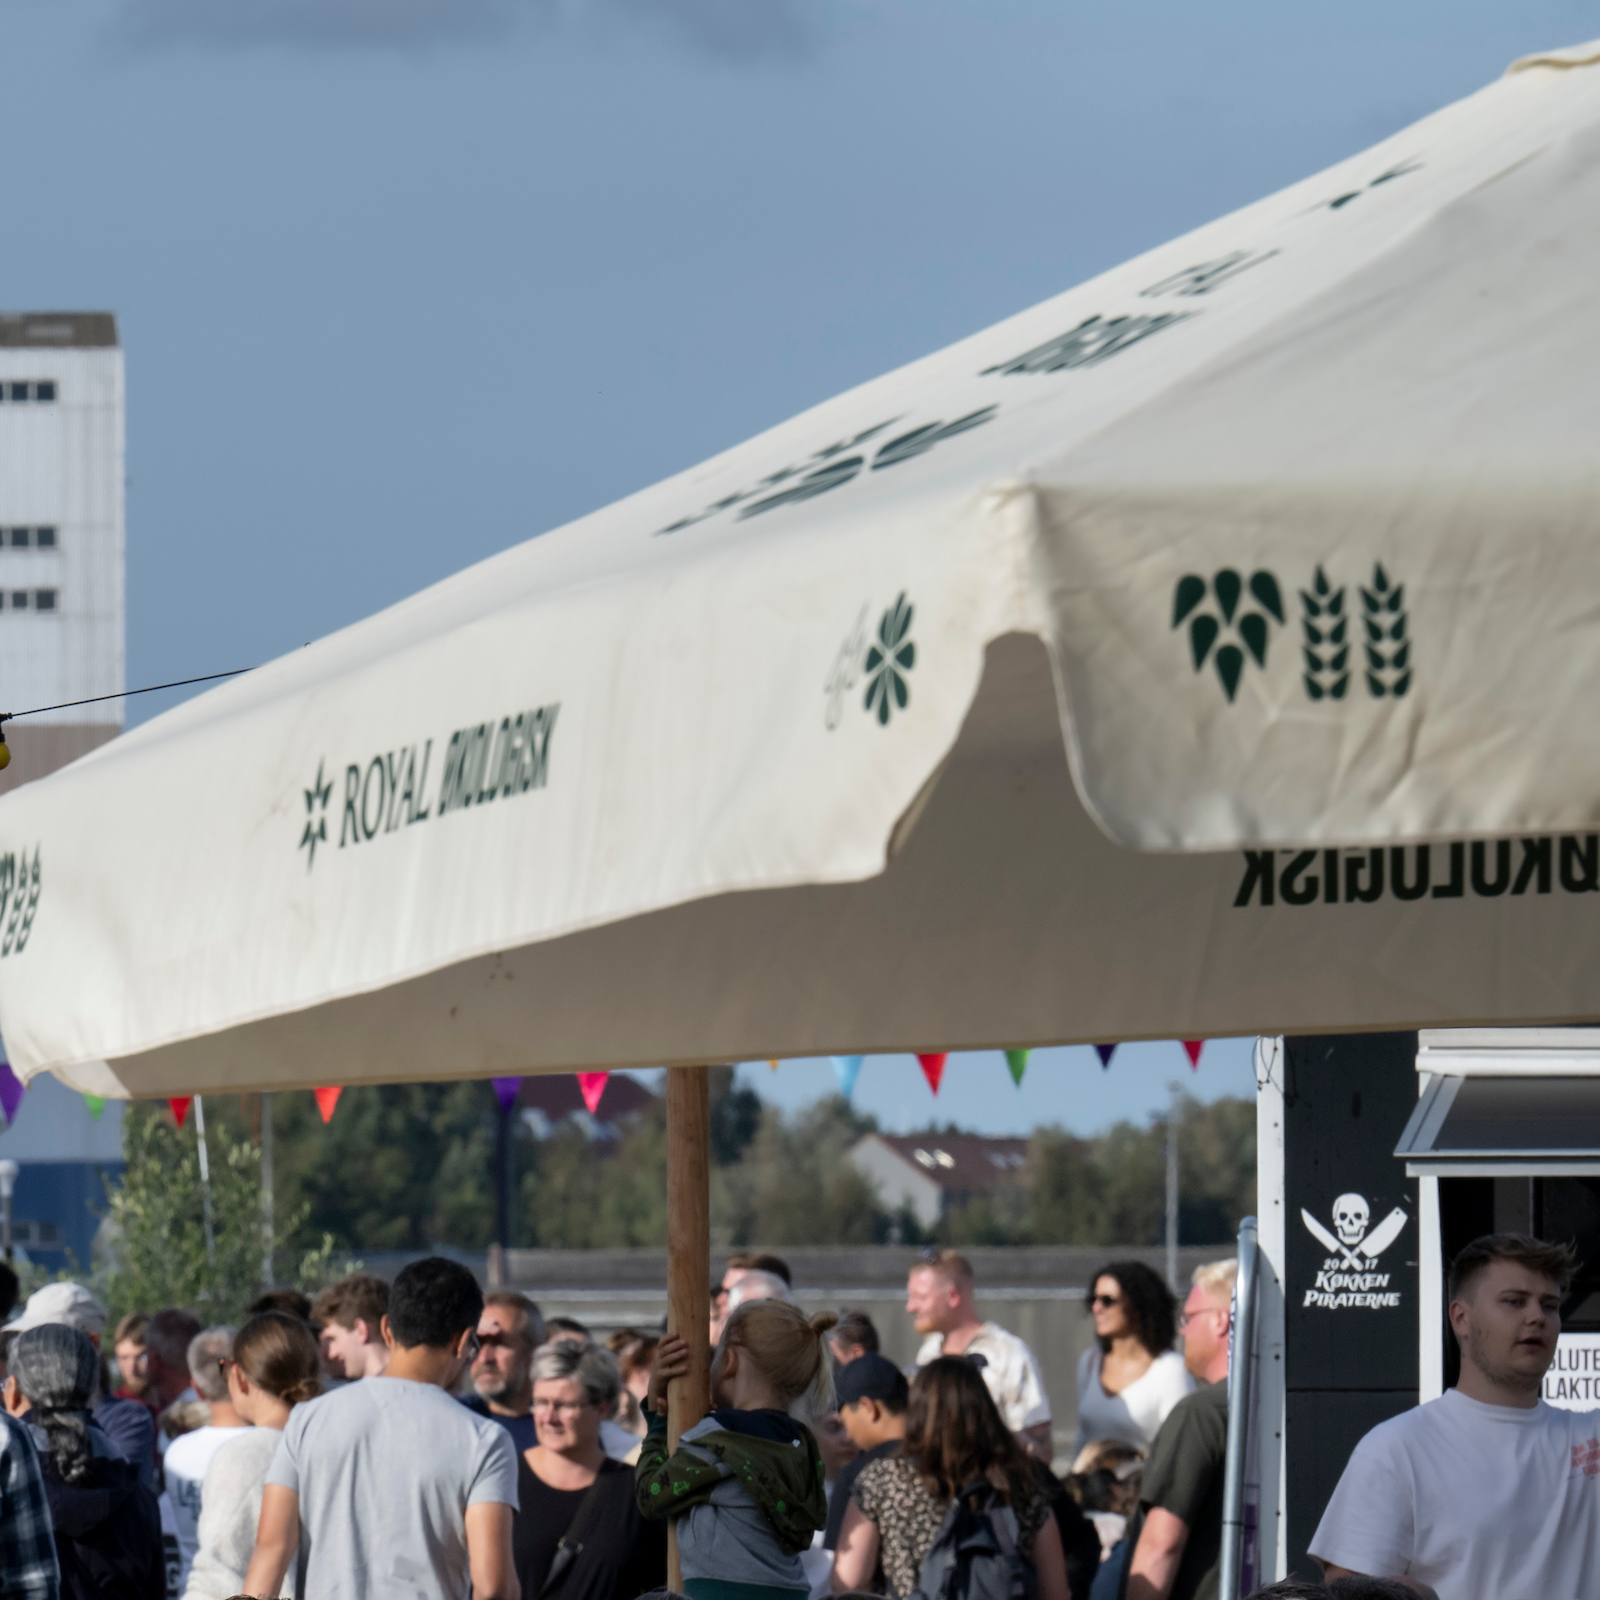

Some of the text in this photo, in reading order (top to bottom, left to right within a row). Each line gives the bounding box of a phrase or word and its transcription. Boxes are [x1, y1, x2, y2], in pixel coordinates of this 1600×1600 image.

[338, 738, 433, 849] ROYAL
[1323, 1258, 1378, 1270] 20 17
[1302, 1289, 1401, 1310] PIRATERNE
[1548, 1348, 1600, 1371] LUTE
